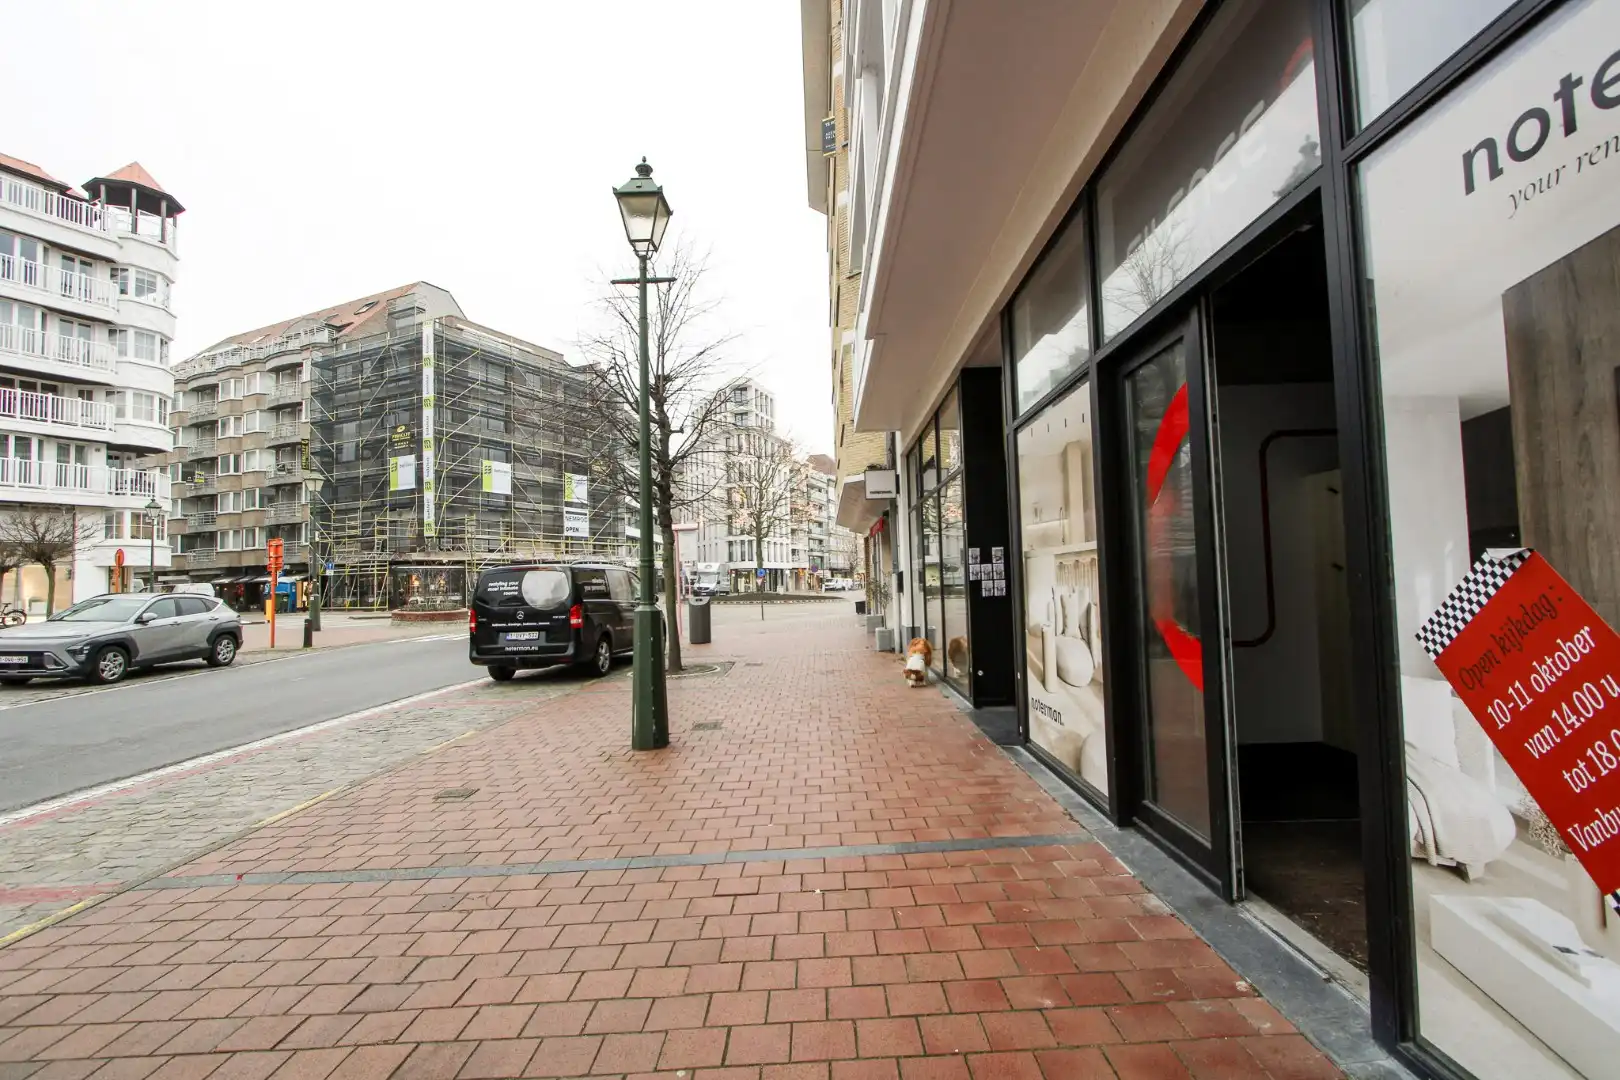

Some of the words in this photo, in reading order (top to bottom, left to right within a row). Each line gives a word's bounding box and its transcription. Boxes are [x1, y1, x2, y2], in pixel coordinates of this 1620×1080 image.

[1508, 165, 1567, 219] your
[1458, 648, 1501, 691] Open
[1487, 679, 1534, 731] 10-11
[1530, 625, 1596, 694] oktober
[1524, 724, 1561, 760] van
[1551, 682, 1605, 737] 14.00
[1562, 758, 1596, 794] tot
